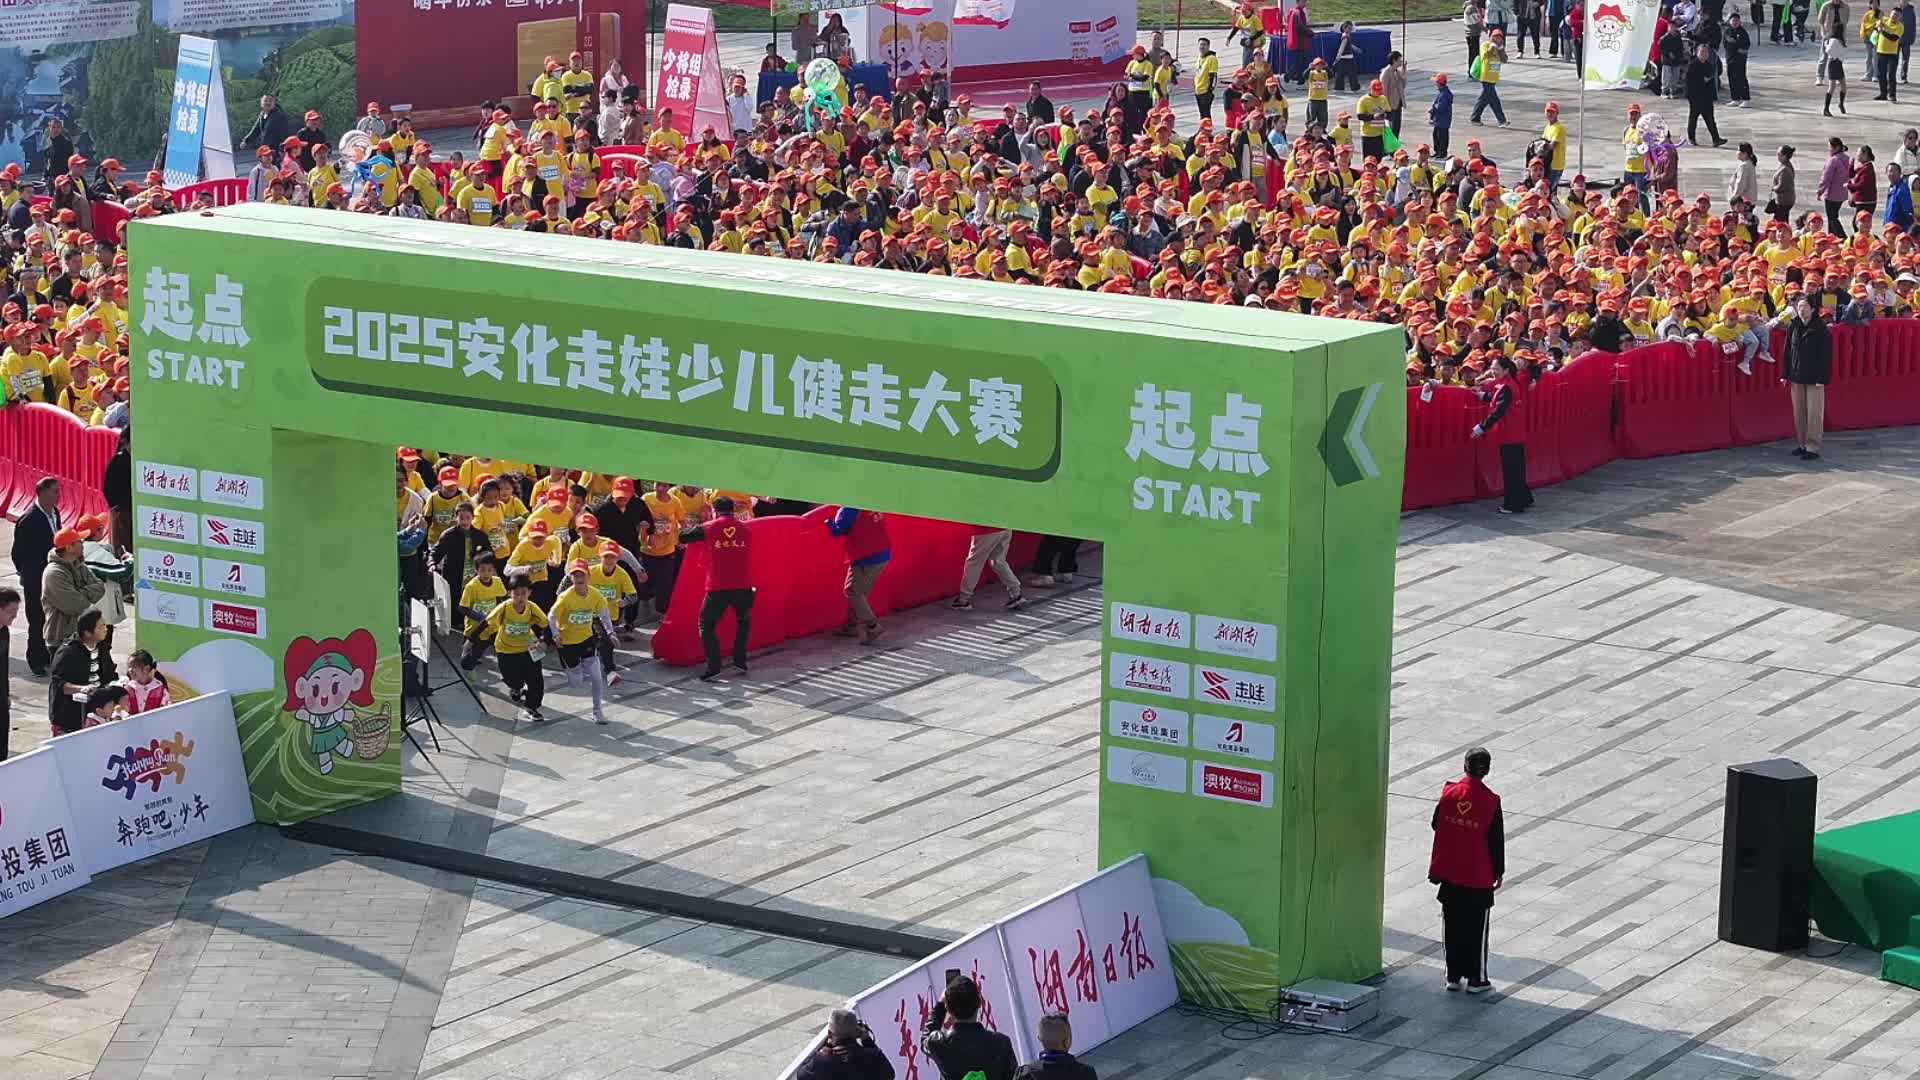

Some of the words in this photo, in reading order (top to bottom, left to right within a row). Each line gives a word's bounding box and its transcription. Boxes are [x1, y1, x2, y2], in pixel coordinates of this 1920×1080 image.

[662, 48, 702, 76] 少将组
[174, 78, 208, 108] 中将组
[665, 74, 691, 101] 检录
[175, 105, 198, 135] 检录
[140, 266, 251, 348] 起点
[147, 348, 245, 390] START
[323, 305, 1023, 450] 2025安化走娃少儿健走大赛
[1125, 382, 1271, 478] 起点
[143, 465, 191, 493] 湖南日报
[215, 477, 249, 498] 新湖南
[1132, 476, 1261, 525] START
[147, 565, 192, 581] 安化城投集团
[213, 610, 235, 626] 澳牧
[1119, 607, 1181, 640] 湖南日报
[1214, 621, 1259, 647] 新湖南
[1121, 720, 1179, 740] 安化城投集团
[122, 755, 155, 781] Happy
[153, 748, 177, 767] Run
[1204, 773, 1232, 791] 澳牧
[0, 827, 71, 884] 投集团
[16, 878, 36, 896] TOU
[40, 872, 49, 887] JI
[51, 861, 76, 881] TUAN
[1027, 911, 1155, 1015] 湖南日报
